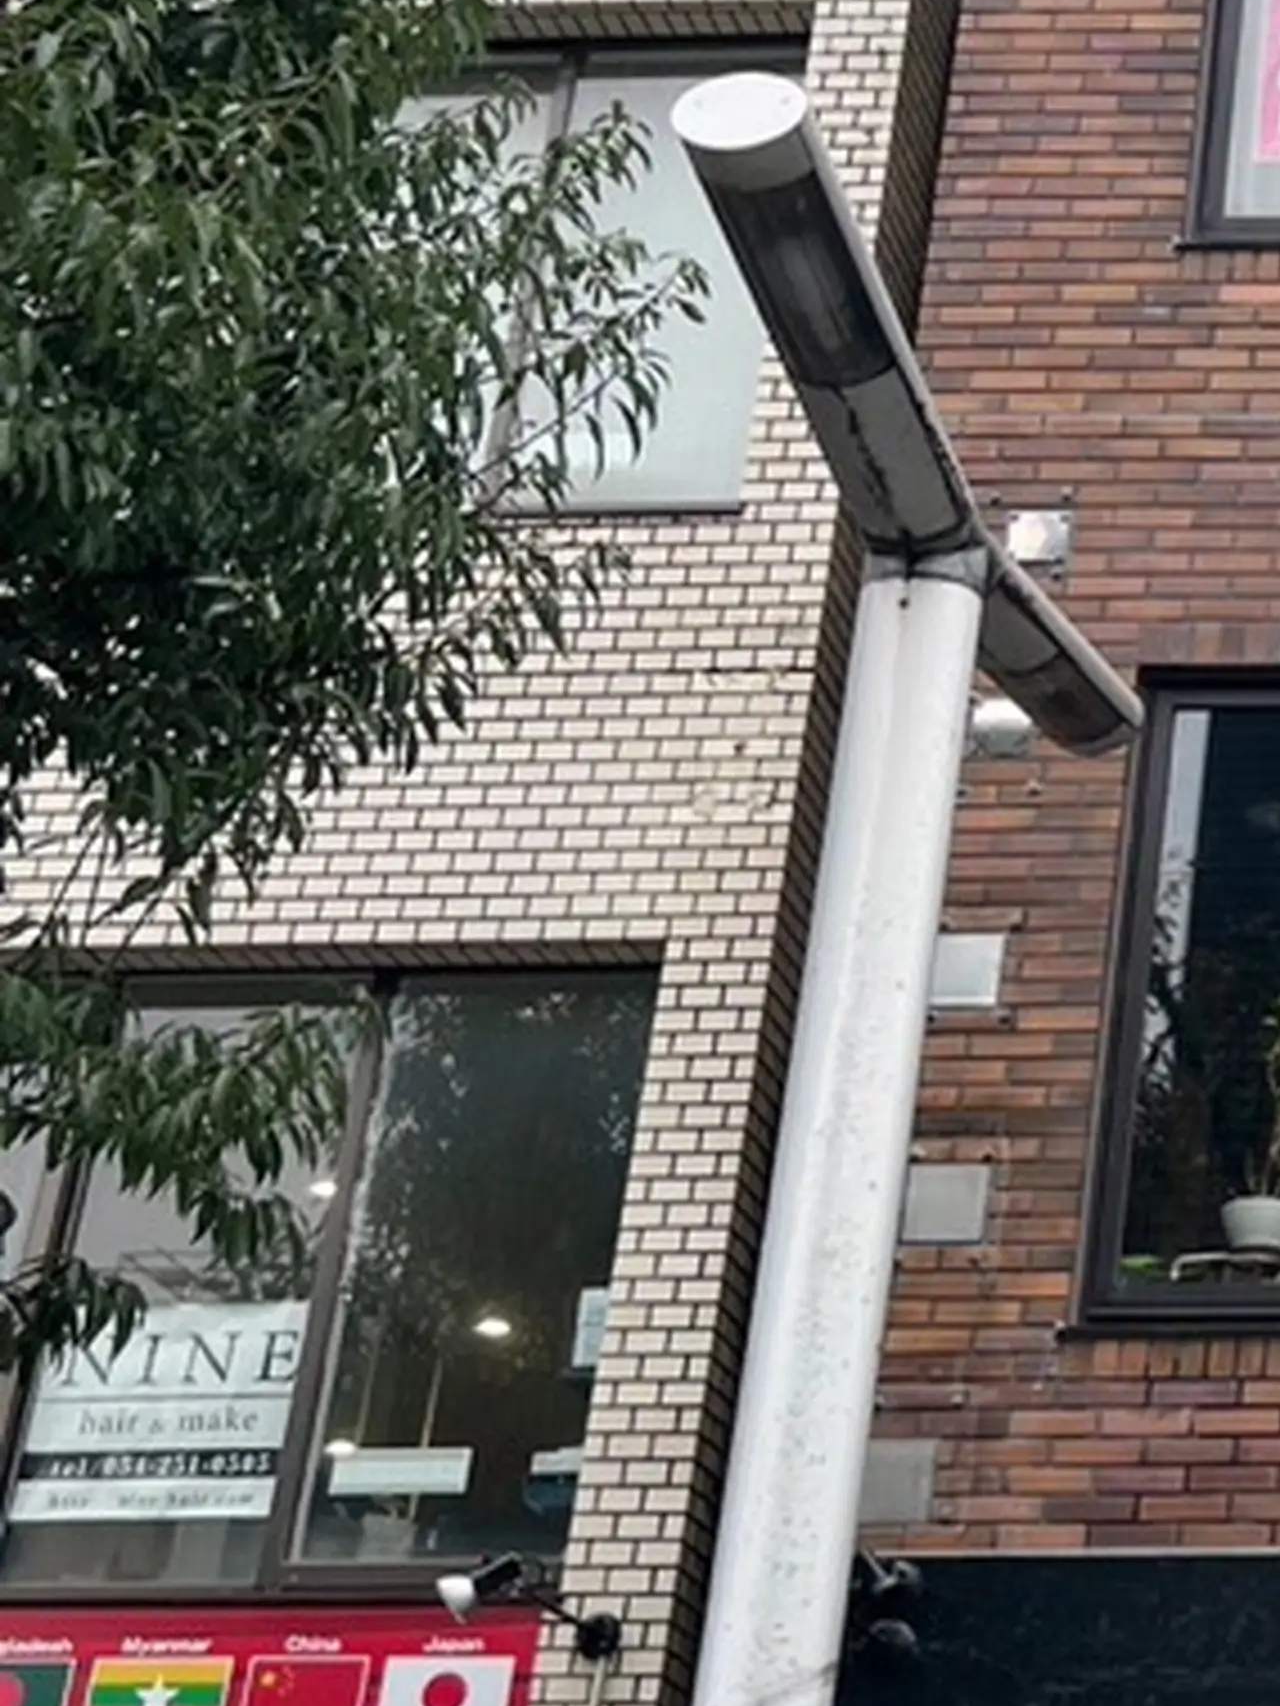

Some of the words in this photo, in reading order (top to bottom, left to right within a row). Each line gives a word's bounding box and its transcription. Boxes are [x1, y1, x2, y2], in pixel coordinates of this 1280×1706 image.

[61, 1329, 299, 1386] NINE
[78, 1405, 140, 1436] hair
[177, 1405, 259, 1434] make
[121, 1635, 212, 1657] Myanmar
[284, 1633, 342, 1653] China
[422, 1634, 486, 1654] Japan
